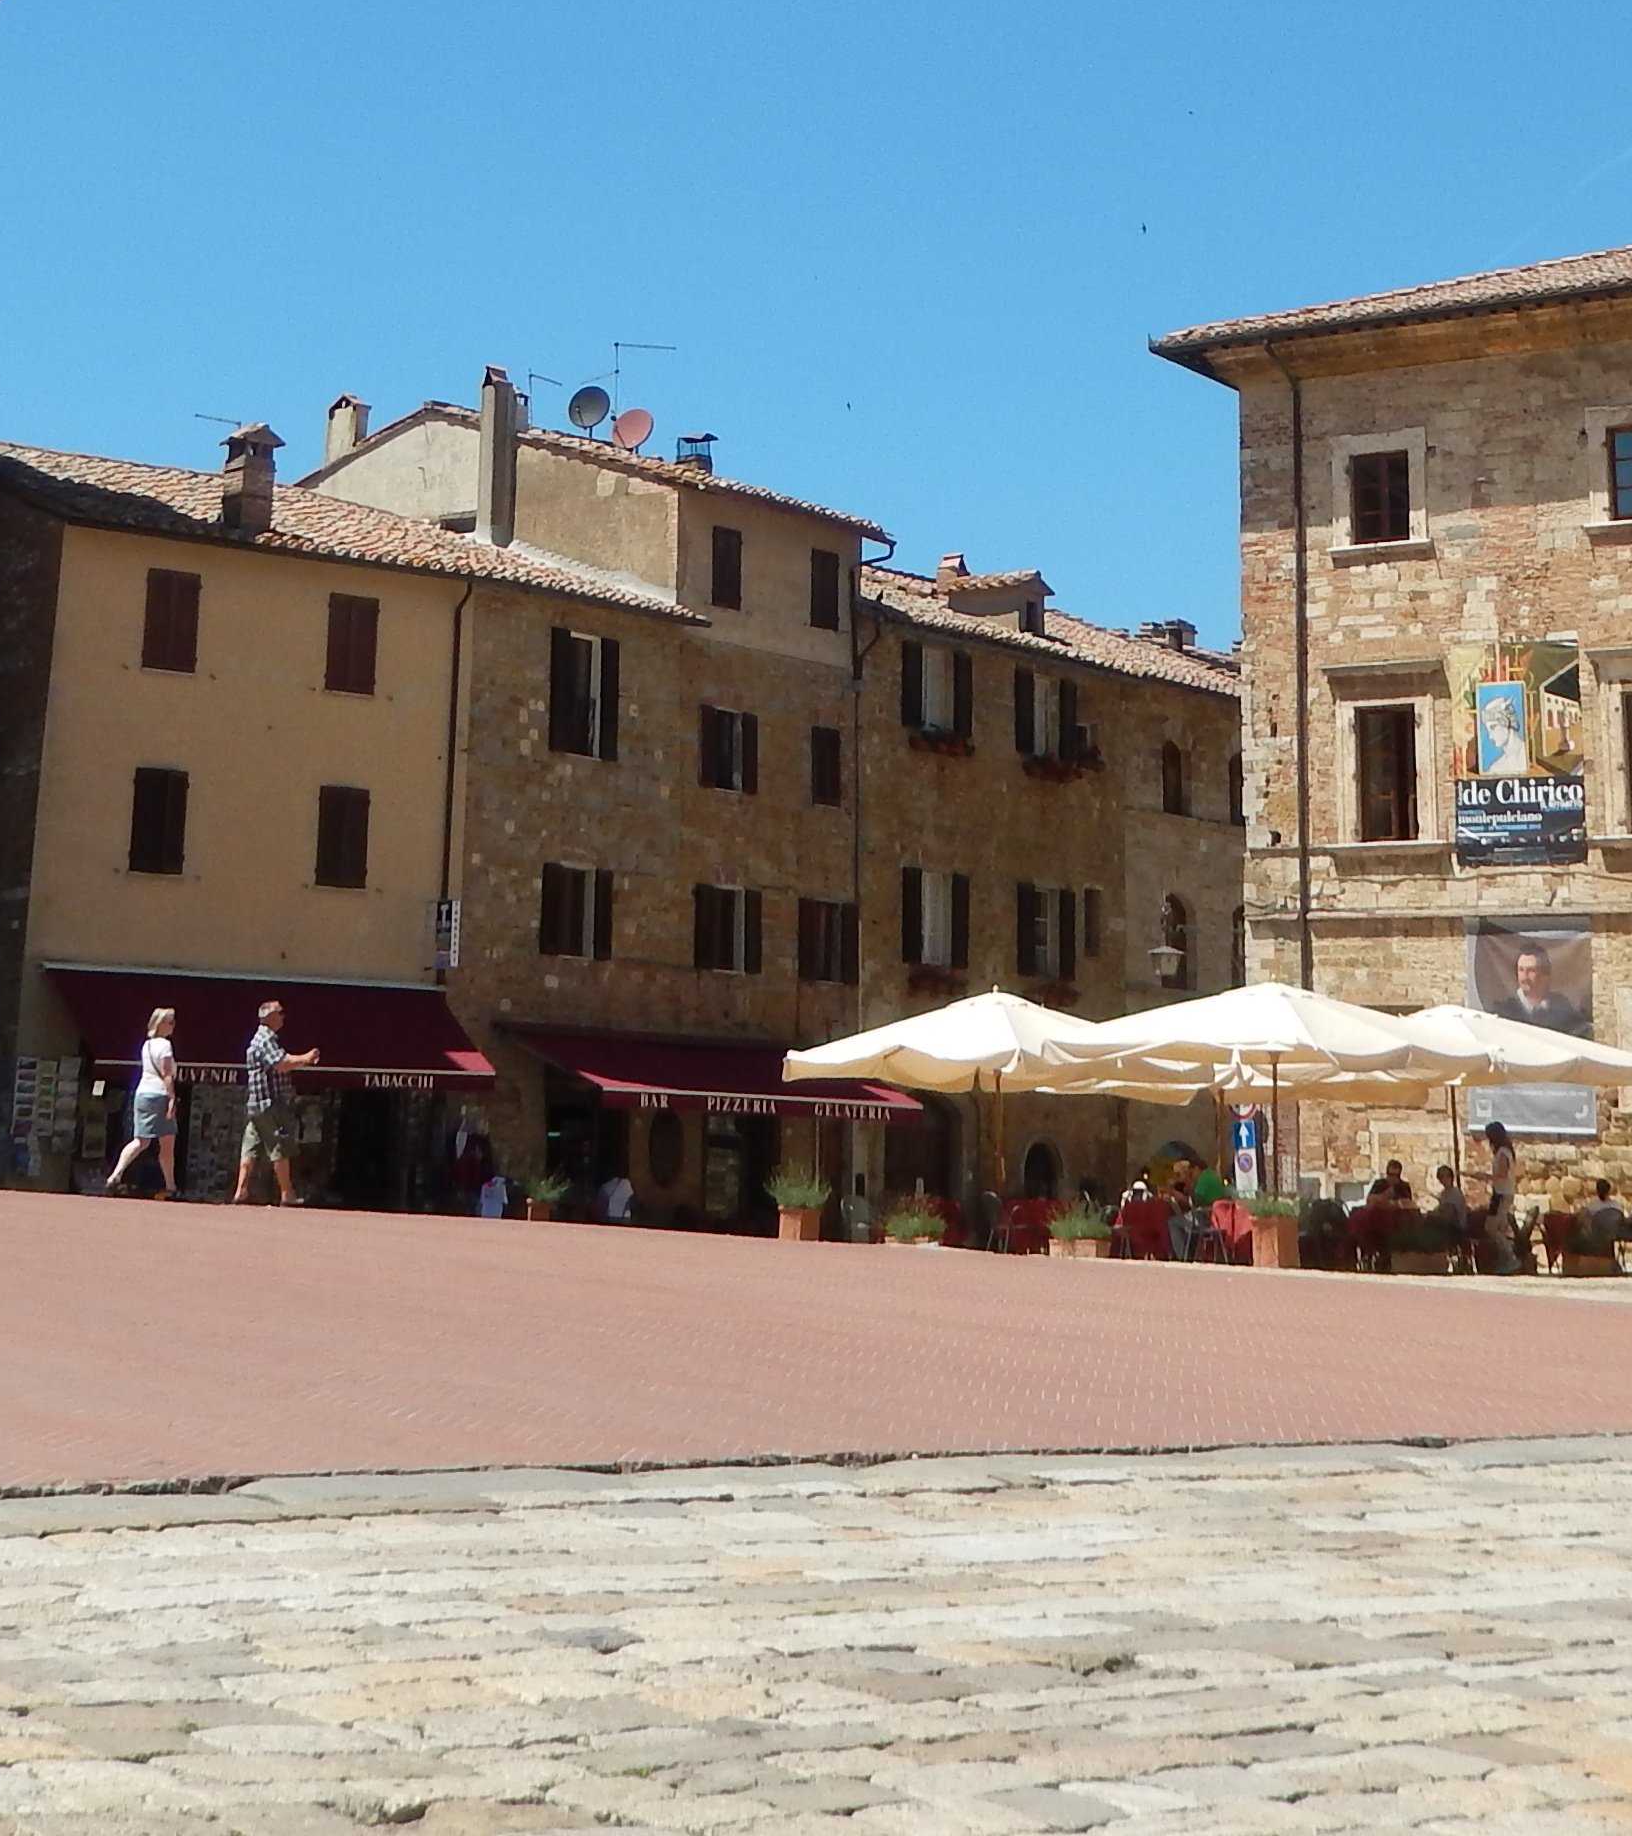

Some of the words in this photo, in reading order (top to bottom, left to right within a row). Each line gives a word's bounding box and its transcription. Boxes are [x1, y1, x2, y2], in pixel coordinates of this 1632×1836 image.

[1463, 780, 1491, 806] de
[1495, 777, 1584, 805] Chirico
[1457, 810, 1543, 827] montepulciano
[177, 1067, 239, 1084] UVENIR
[364, 1073, 435, 1089] TABACCHI
[639, 1092, 669, 1109] BAR
[706, 1096, 777, 1115] PIZZERIA
[814, 1102, 892, 1121] GELATERIA
